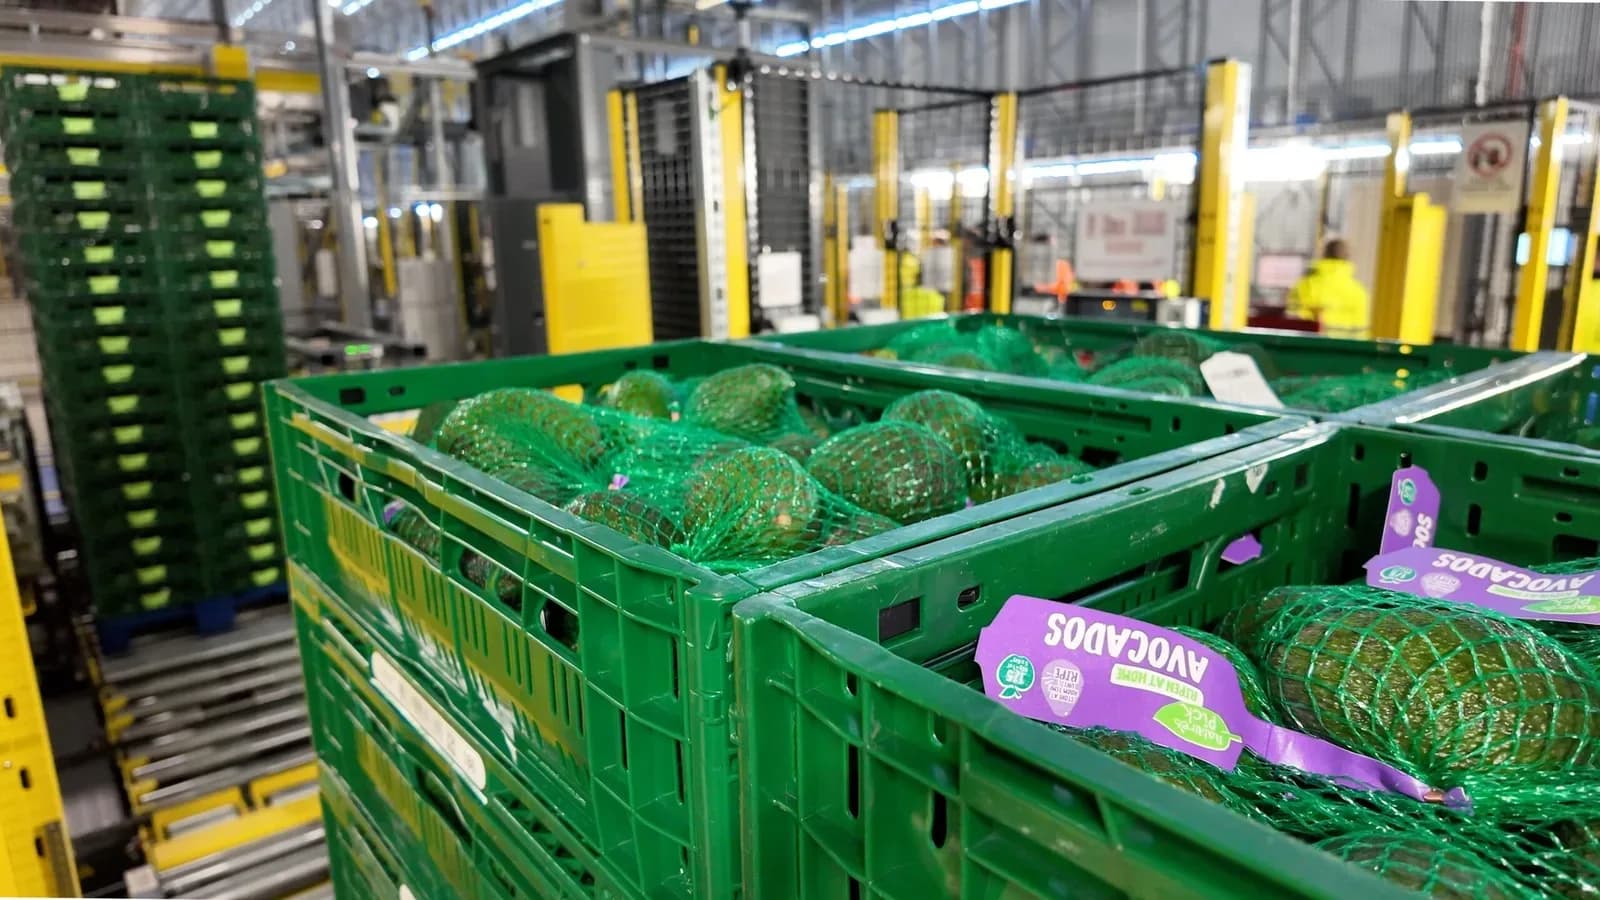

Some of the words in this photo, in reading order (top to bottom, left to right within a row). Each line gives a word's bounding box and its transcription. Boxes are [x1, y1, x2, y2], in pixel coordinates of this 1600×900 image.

[1432, 554, 1595, 592] AVOCADOS
[1044, 613, 1209, 683] AVOCADOS
[1055, 668, 1079, 682] RIPE
[1116, 667, 1148, 684] HOME
[1148, 674, 1165, 688] AT
[1166, 680, 1198, 701] RIPEN
[1181, 704, 1217, 730] Pick
